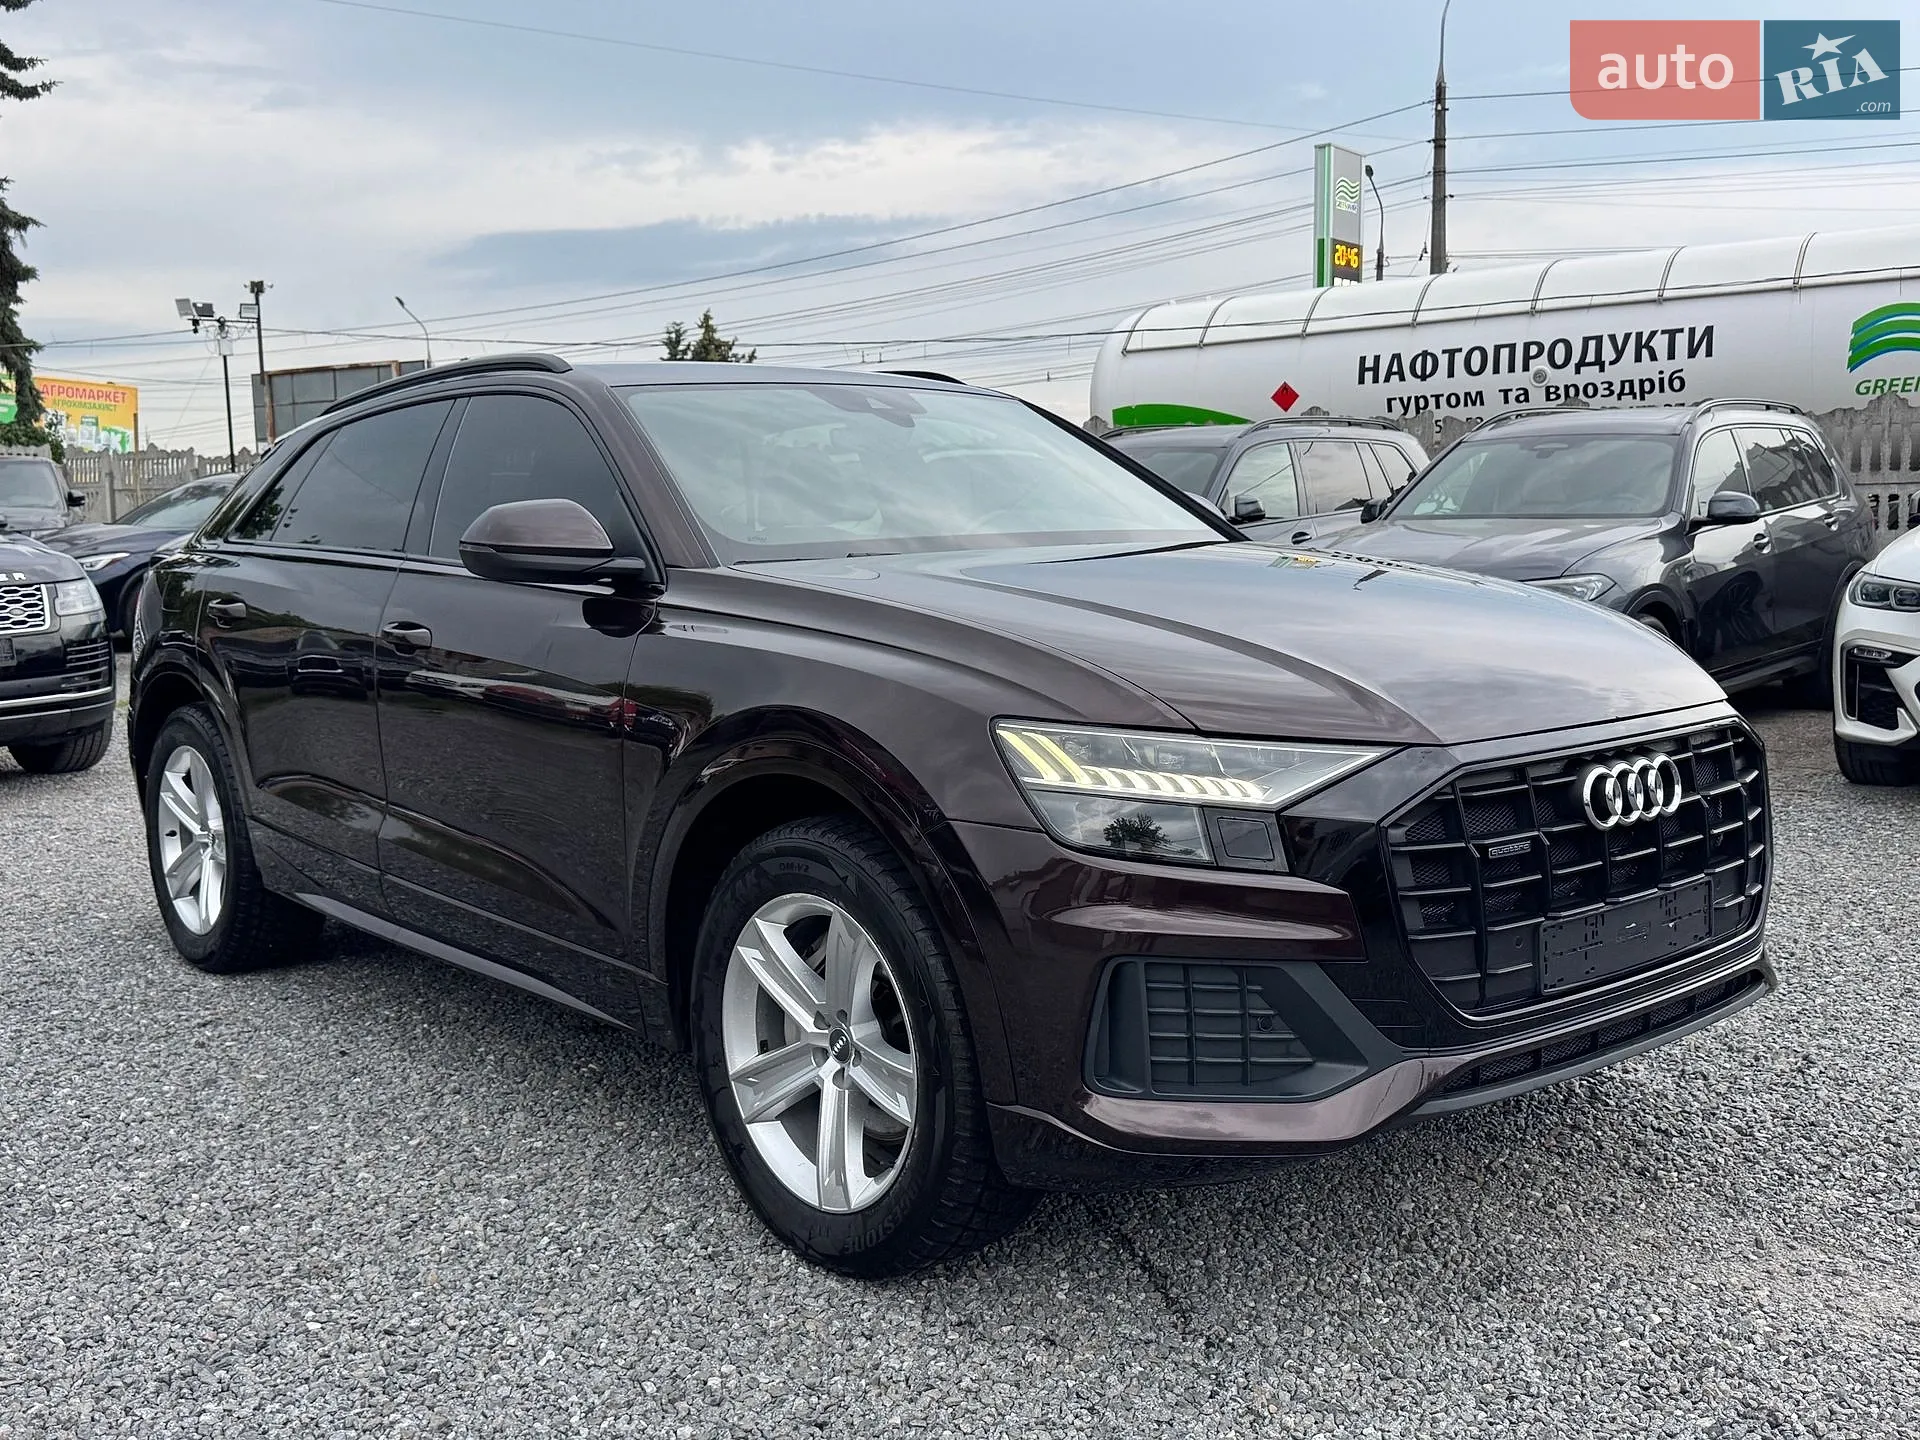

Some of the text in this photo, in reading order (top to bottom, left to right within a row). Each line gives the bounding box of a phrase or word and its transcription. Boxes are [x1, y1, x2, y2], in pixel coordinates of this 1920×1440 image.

[1357, 325, 1715, 385] НАФТОПРОДУКТИ
[41, 384, 128, 403] АГРОМАРКЕТ
[1386, 369, 1687, 416] гуртом та вроздріб
